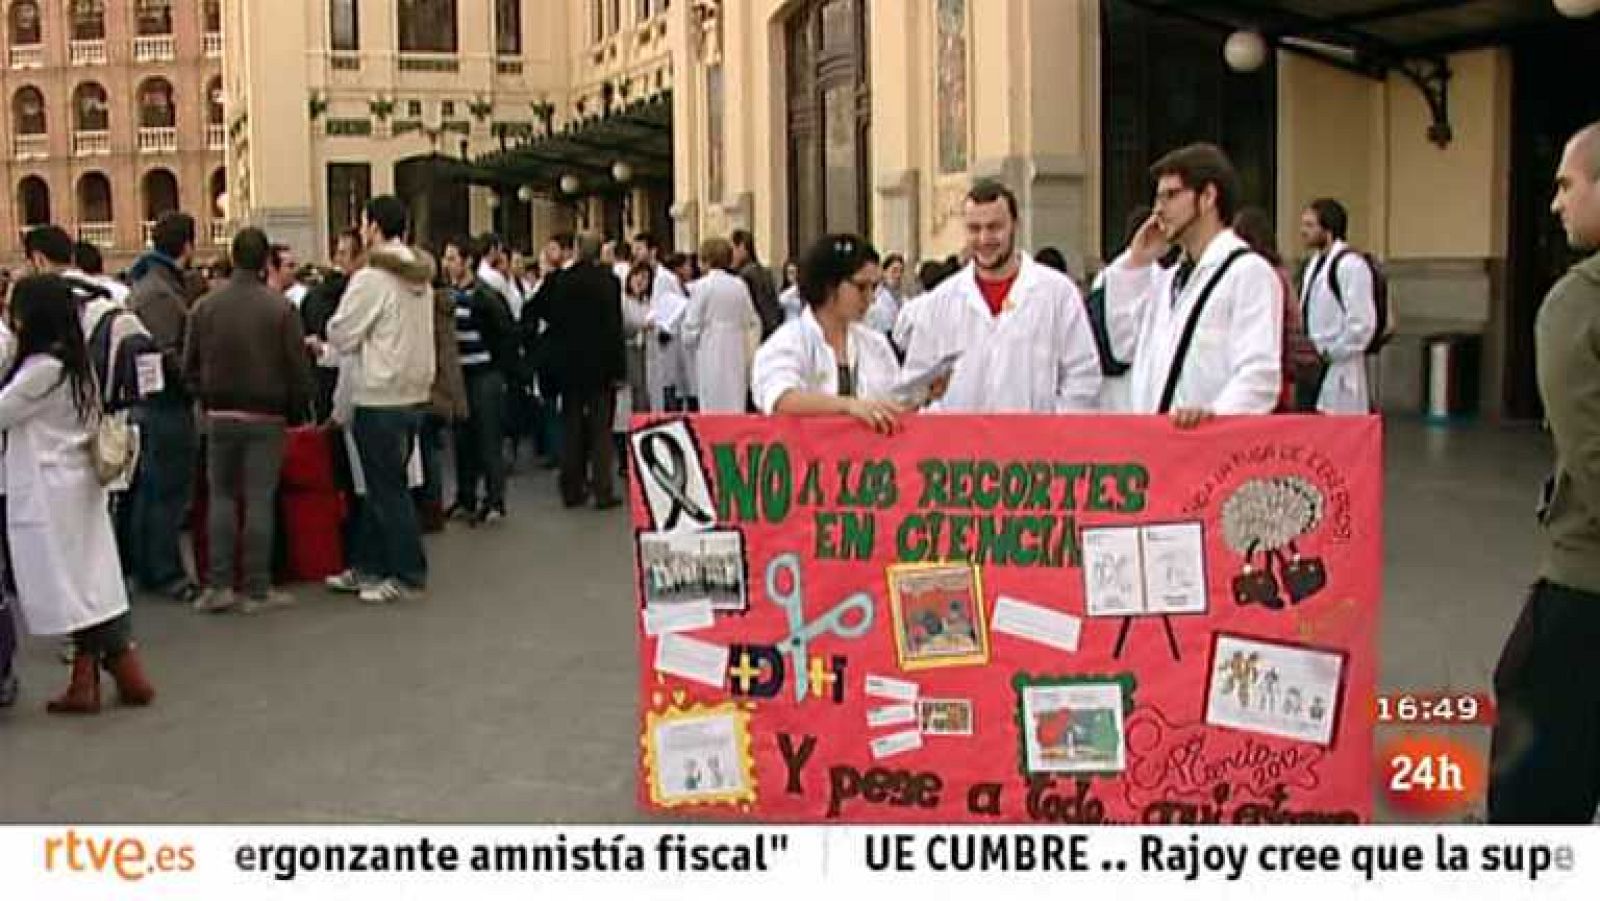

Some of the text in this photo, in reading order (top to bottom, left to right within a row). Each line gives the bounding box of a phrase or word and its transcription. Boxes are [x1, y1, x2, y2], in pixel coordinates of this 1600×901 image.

[709, 442, 1150, 523] NO A LOS RECORTES
[815, 512, 1083, 566] EN CIENCIA
[776, 732, 818, 796] Y
[967, 782, 1004, 817] a
